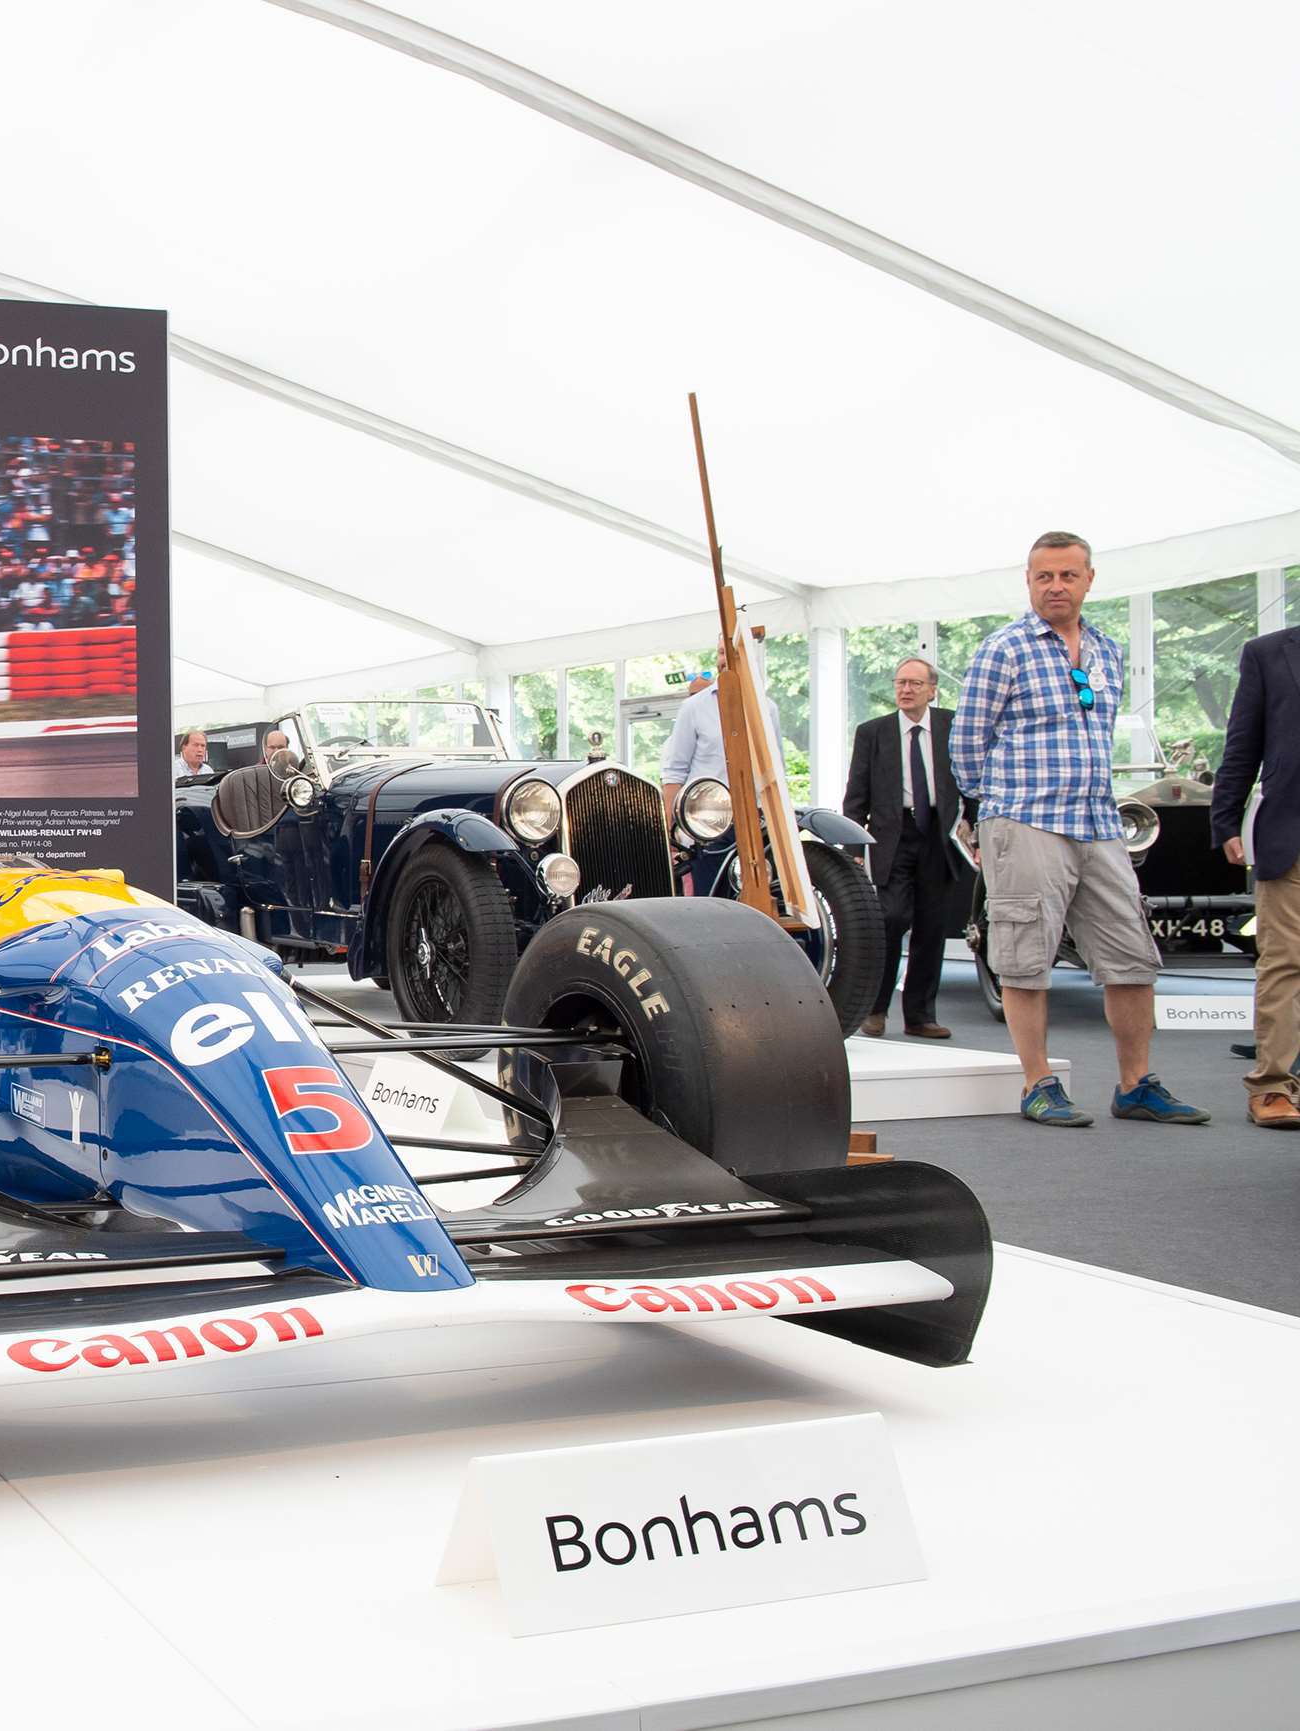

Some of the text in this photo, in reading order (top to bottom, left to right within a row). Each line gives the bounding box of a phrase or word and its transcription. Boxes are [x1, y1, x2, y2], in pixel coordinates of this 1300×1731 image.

[0, 829, 75, 837] WILLIAMS-RENAULT
[76, 828, 102, 836] FW14B
[45, 851, 87, 859] department
[576, 927, 670, 1022] EAGLE
[1166, 1008, 1246, 1020] Bonhams
[261, 1066, 374, 1155] 5
[371, 1081, 440, 1115] Bonhams
[328, 1184, 427, 1208] MAGNET
[322, 1202, 436, 1229] MARELL
[544, 1200, 781, 1227] GOODYEAR
[564, 1274, 837, 1313] Canon
[6, 1307, 324, 1372] Canon
[545, 1492, 868, 1573] Bonhams
